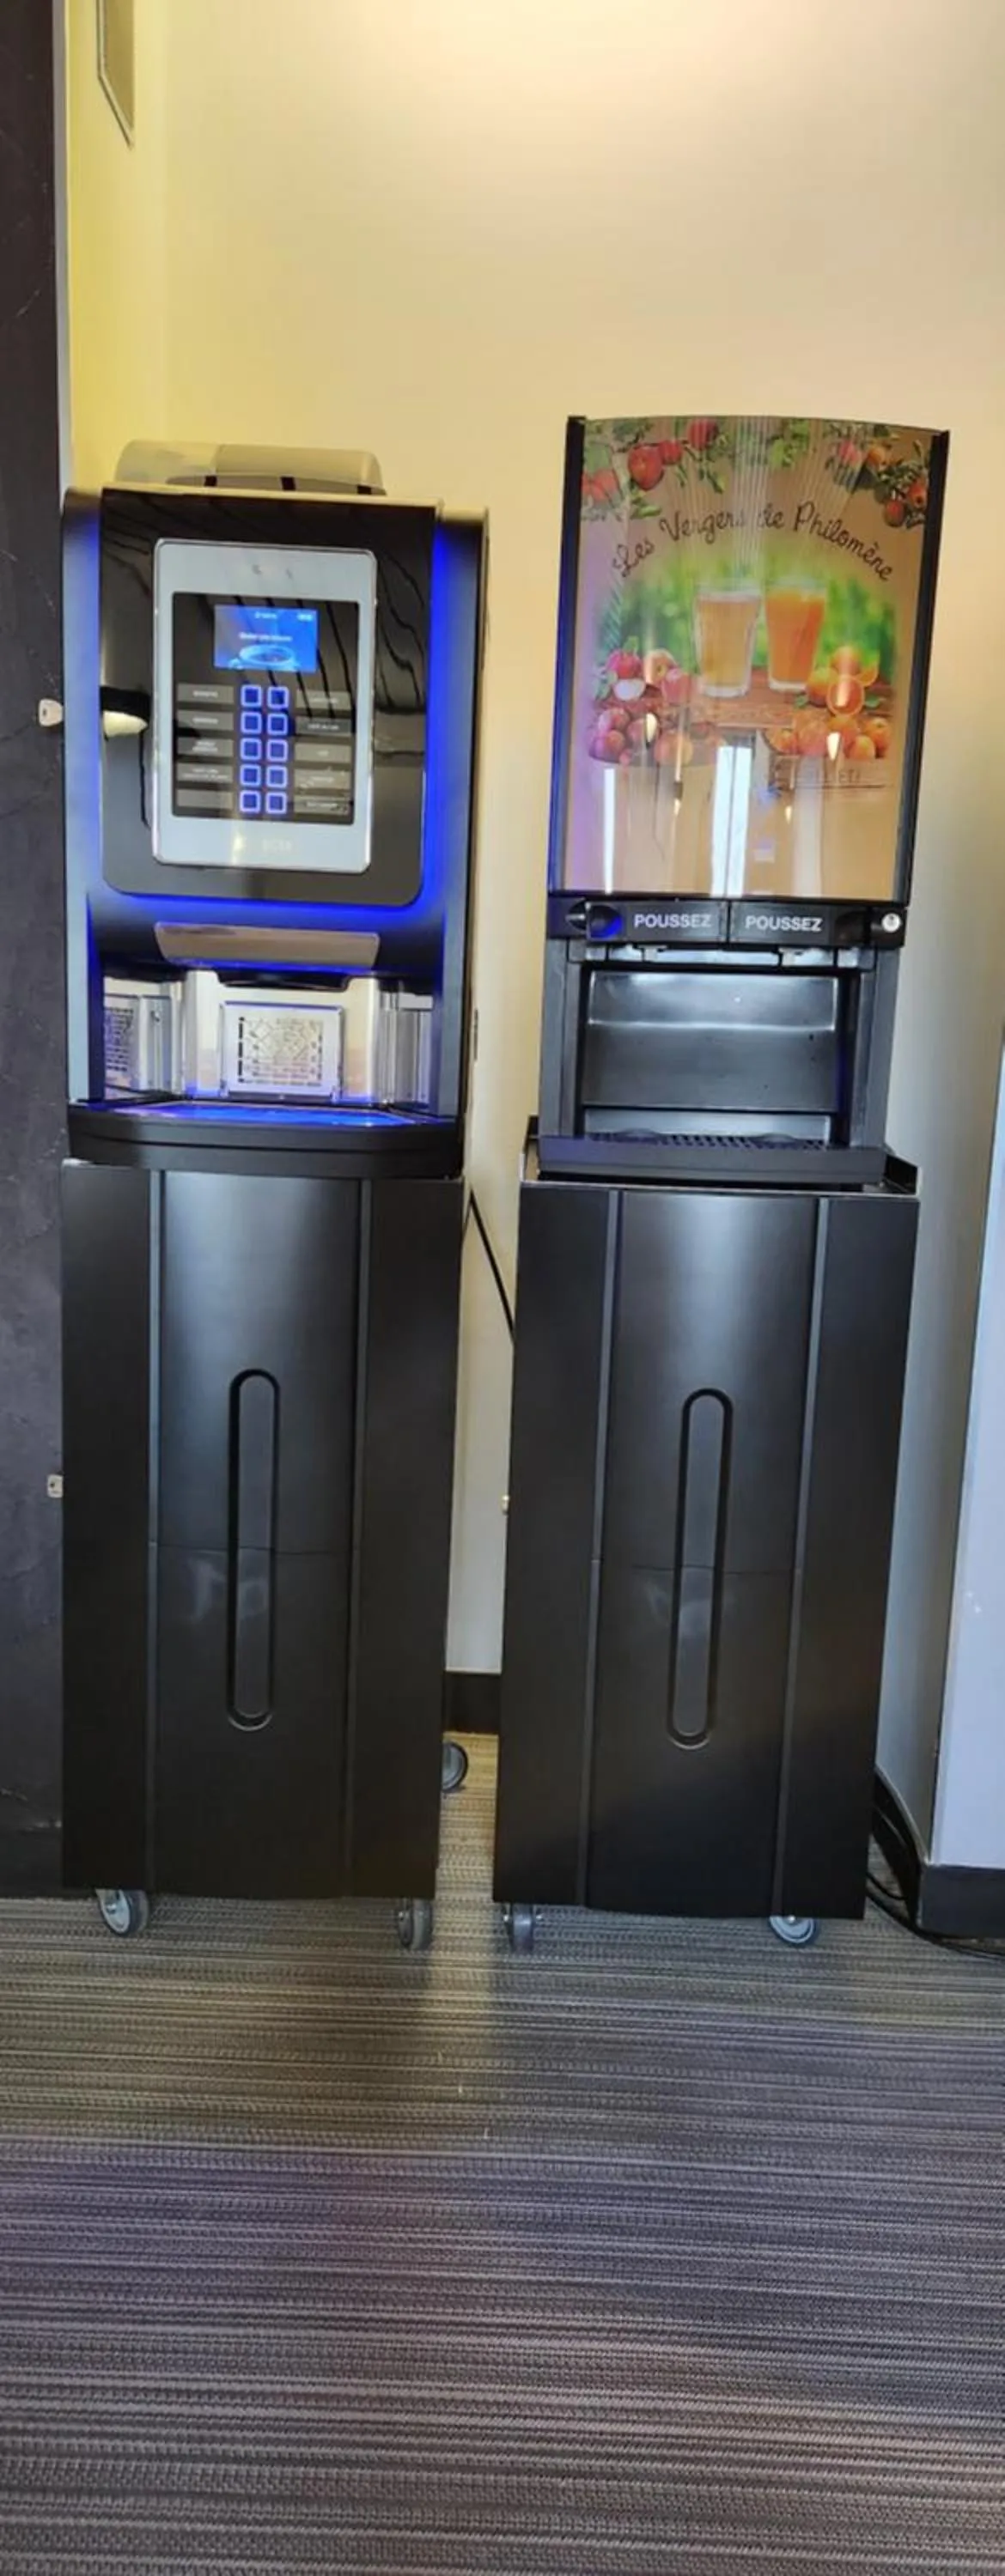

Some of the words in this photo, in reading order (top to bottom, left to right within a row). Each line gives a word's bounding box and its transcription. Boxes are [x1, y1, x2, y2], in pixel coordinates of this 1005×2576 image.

[612, 537, 655, 578] Les
[659, 510, 745, 545] Vergers
[757, 502, 785, 529] de
[794, 501, 893, 582] Philomène
[633, 913, 712, 929] POUSSEZ
[744, 914, 824, 933] POUSSEZ
